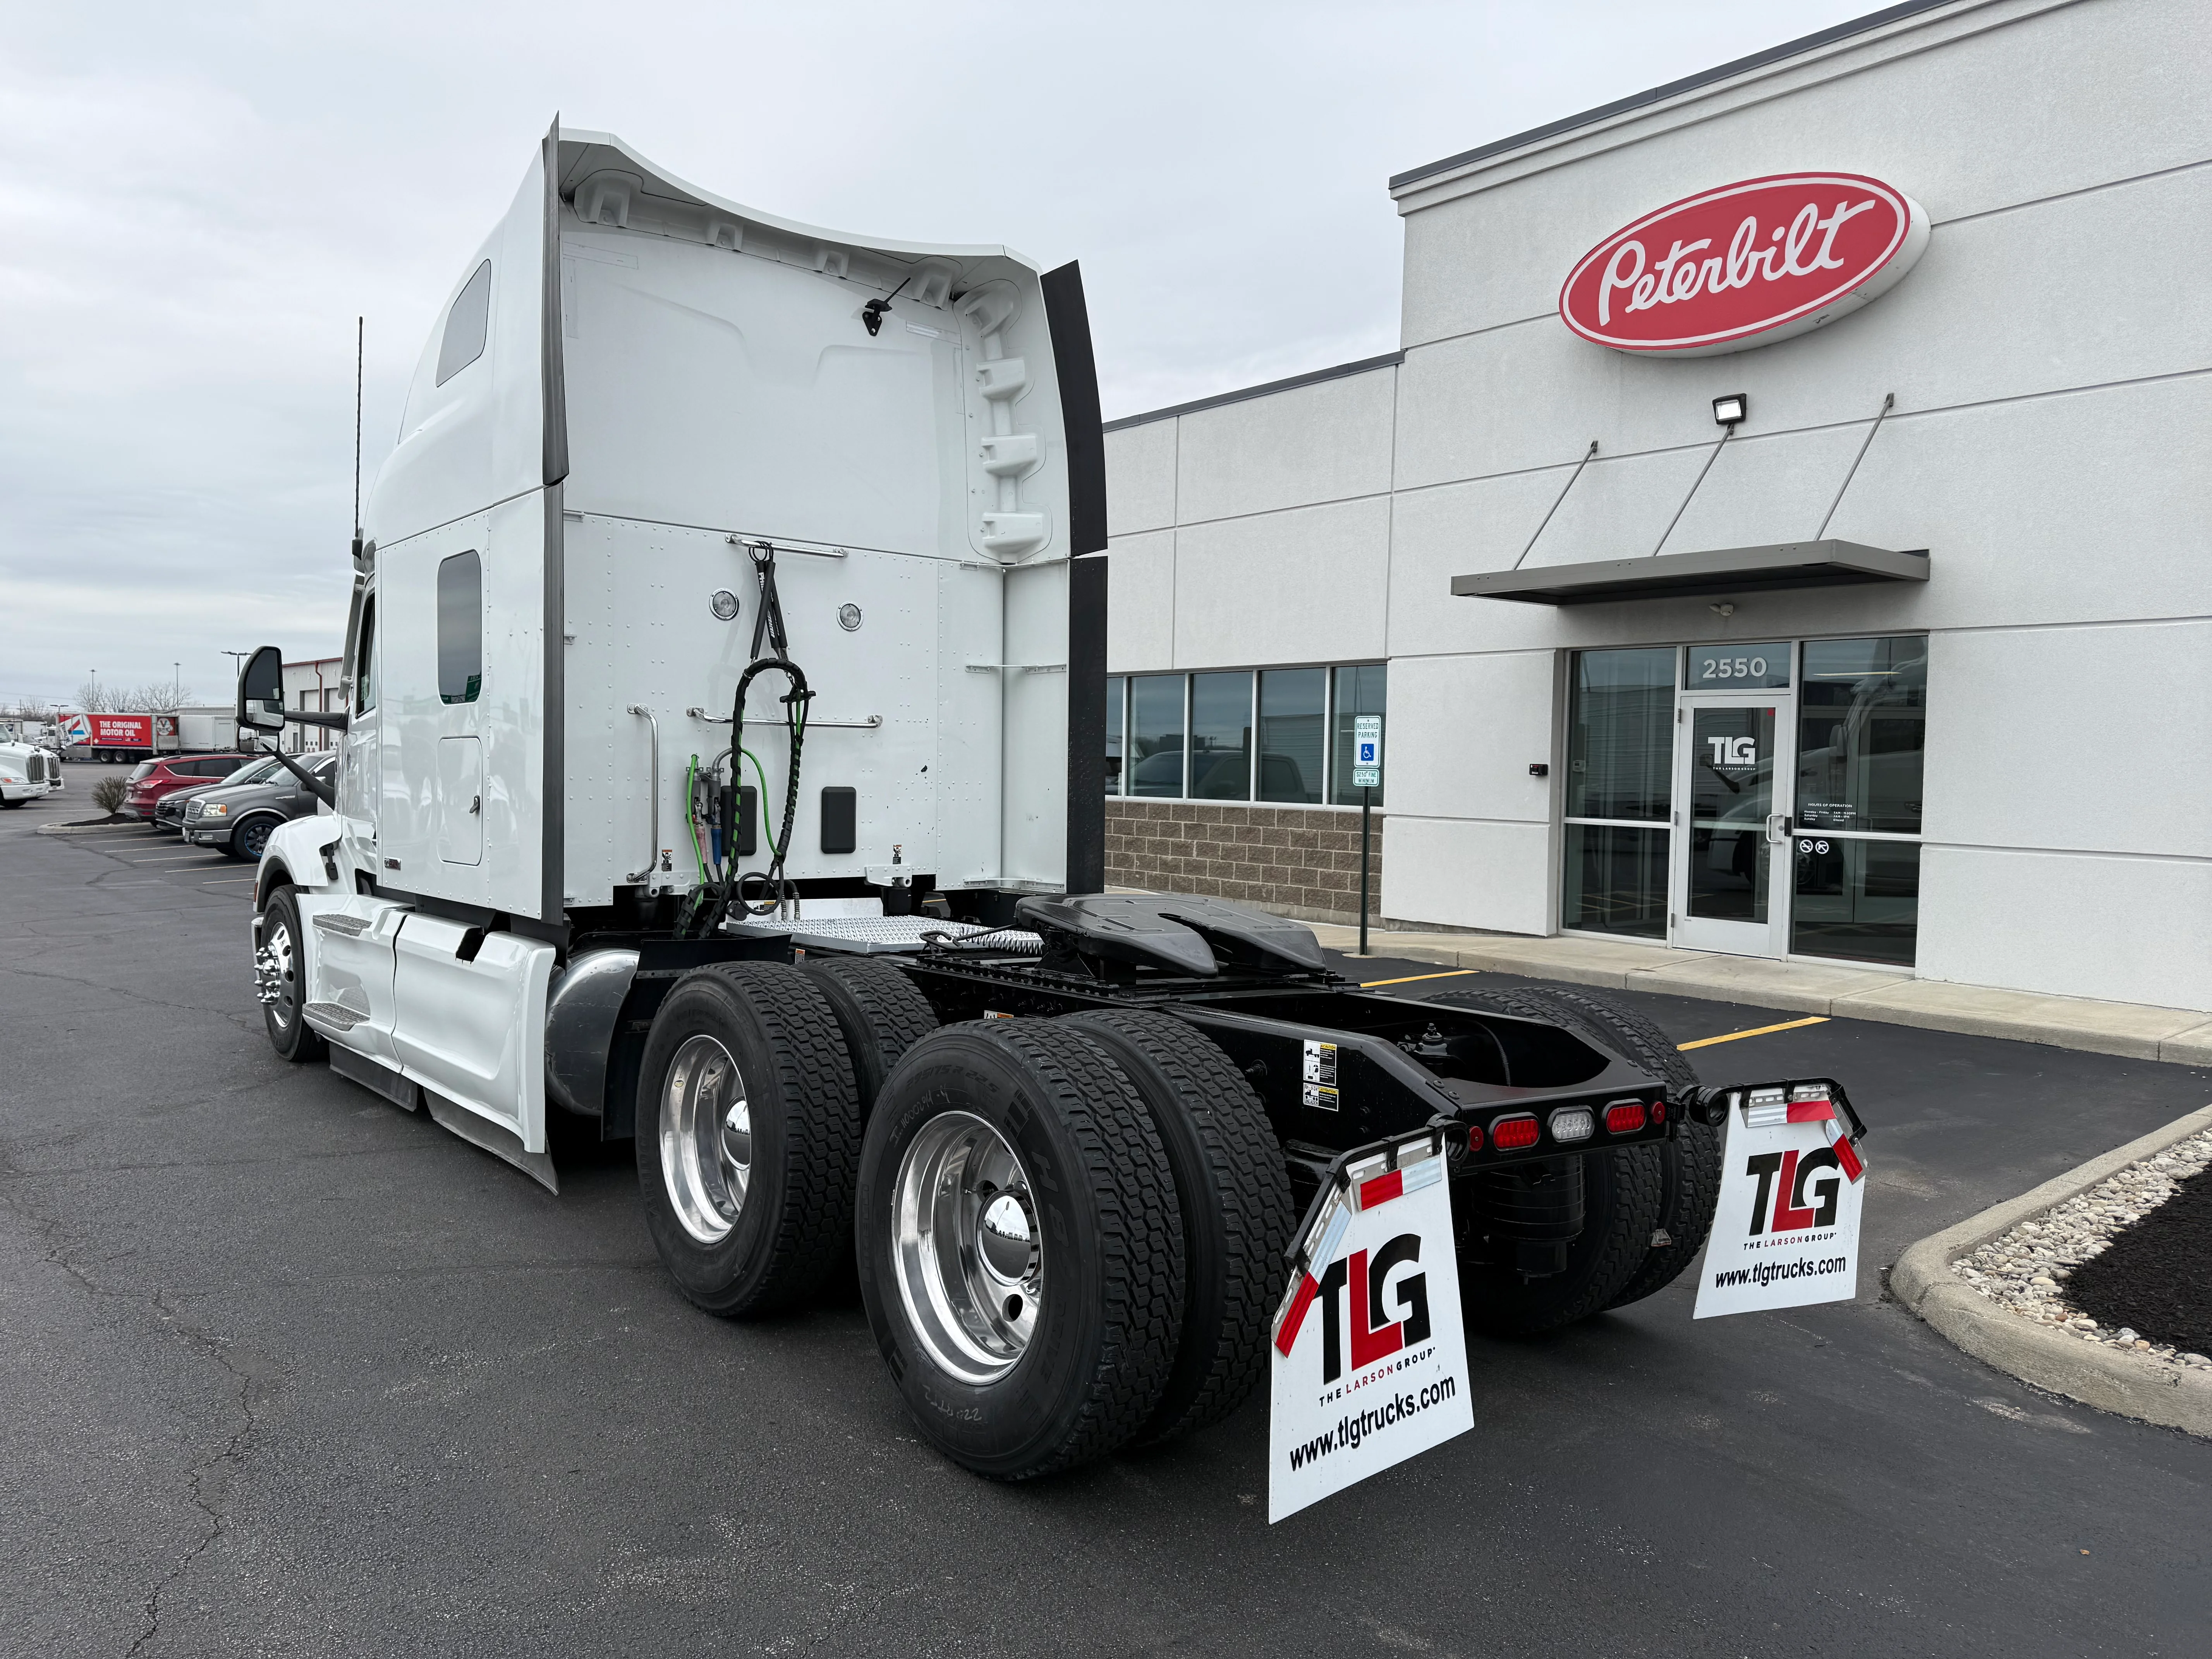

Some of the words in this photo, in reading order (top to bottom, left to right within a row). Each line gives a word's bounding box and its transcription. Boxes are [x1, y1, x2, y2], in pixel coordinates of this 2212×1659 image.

[1598, 199, 1875, 327] Peterbilt
[1703, 657, 1767, 678] 2550
[1708, 737, 1755, 764] TLG
[1746, 1147, 1841, 1236] TLG
[1744, 1241, 1761, 1250] THE
[1764, 1236, 1803, 1247] LARSON
[1805, 1233, 1837, 1242] GROUP
[1716, 1257, 1846, 1288] www.tlgtrucks.com
[1313, 1233, 1431, 1386] TLG
[1319, 1389, 1342, 1408] THE
[1346, 1366, 1394, 1394] LARSON
[1396, 1347, 1436, 1371] GROUP
[1290, 1376, 1456, 1472] www.tlgtrucks.com
